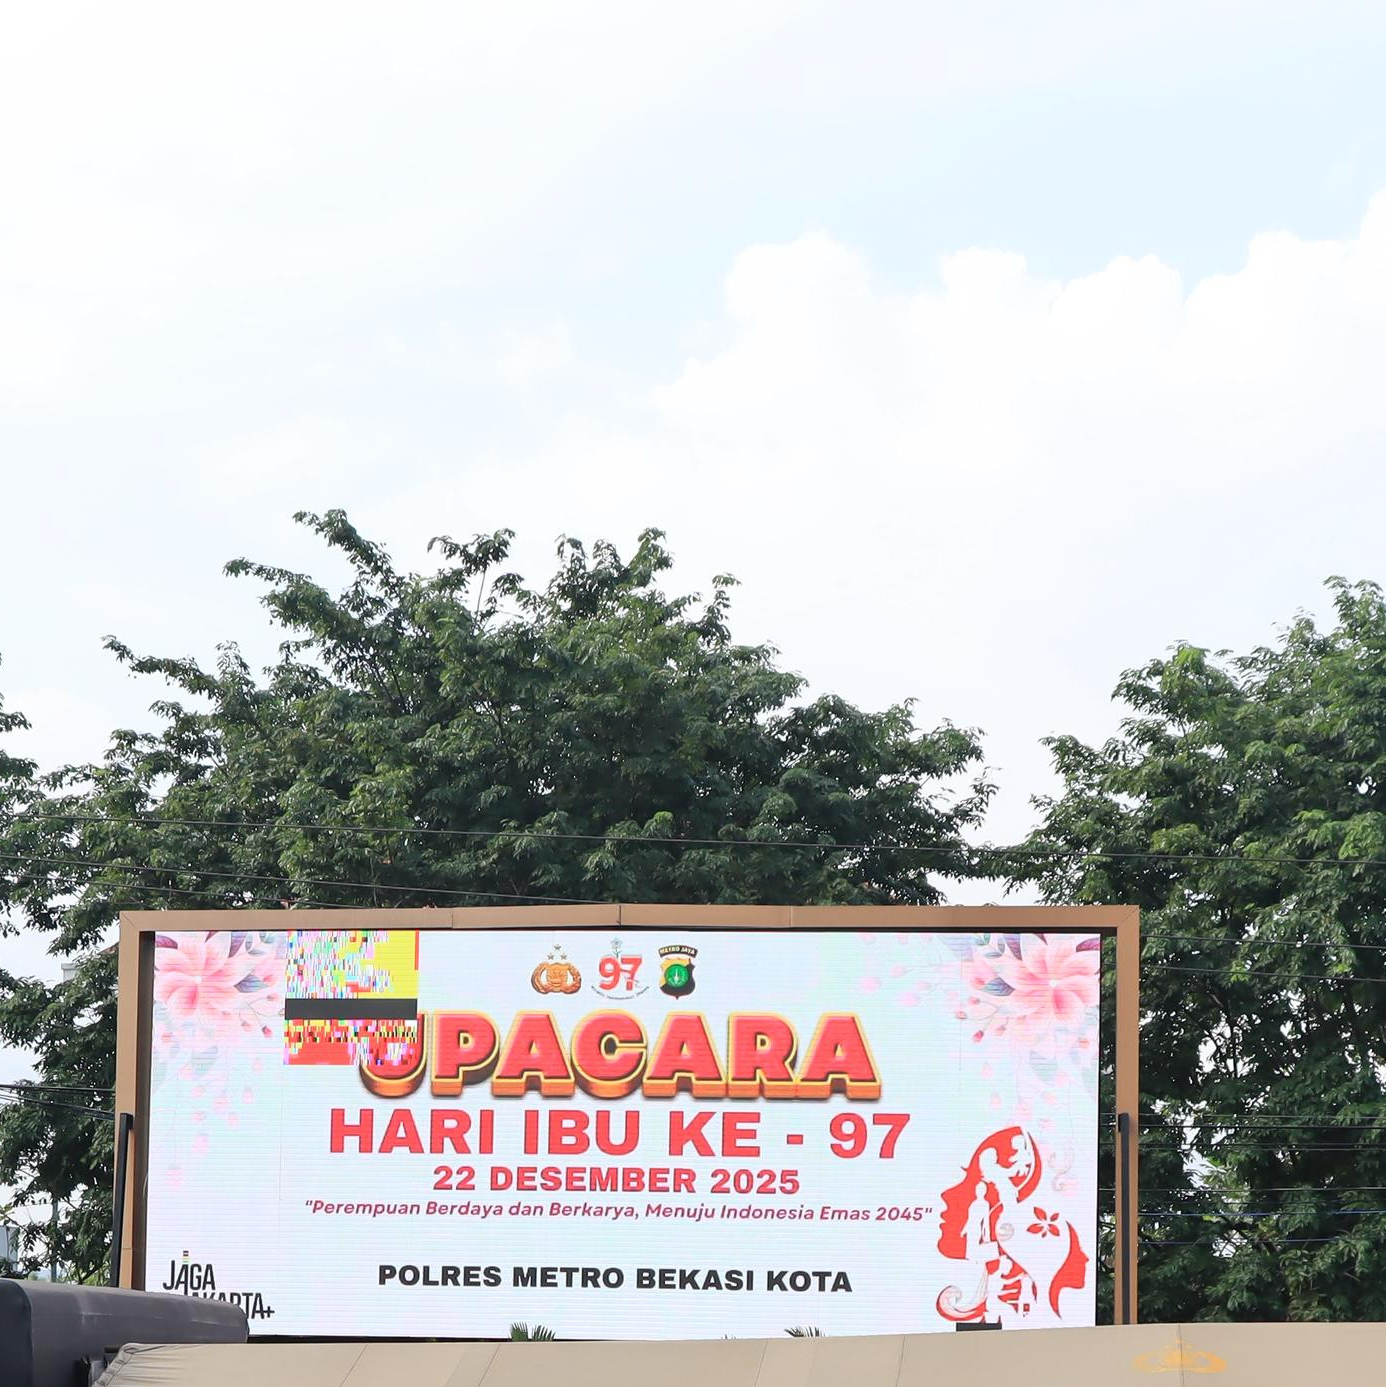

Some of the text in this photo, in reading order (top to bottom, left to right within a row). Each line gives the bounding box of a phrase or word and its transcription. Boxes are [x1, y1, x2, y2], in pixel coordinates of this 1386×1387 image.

[598, 956, 643, 991] 97
[328, 1108, 494, 1156] HARI
[521, 1110, 641, 1157] IBU
[668, 1111, 763, 1158] KE
[829, 1112, 911, 1159] 97
[433, 1165, 800, 1194] 22 DESEMBER 2025
[305, 1199, 933, 1222] "Perempuan Berdaya dan Berkarya, Menuju Indonesia Emas 2045"
[163, 1260, 215, 1291] JAGA
[378, 1264, 853, 1293] POLRES METRO BEKASI KOTA
